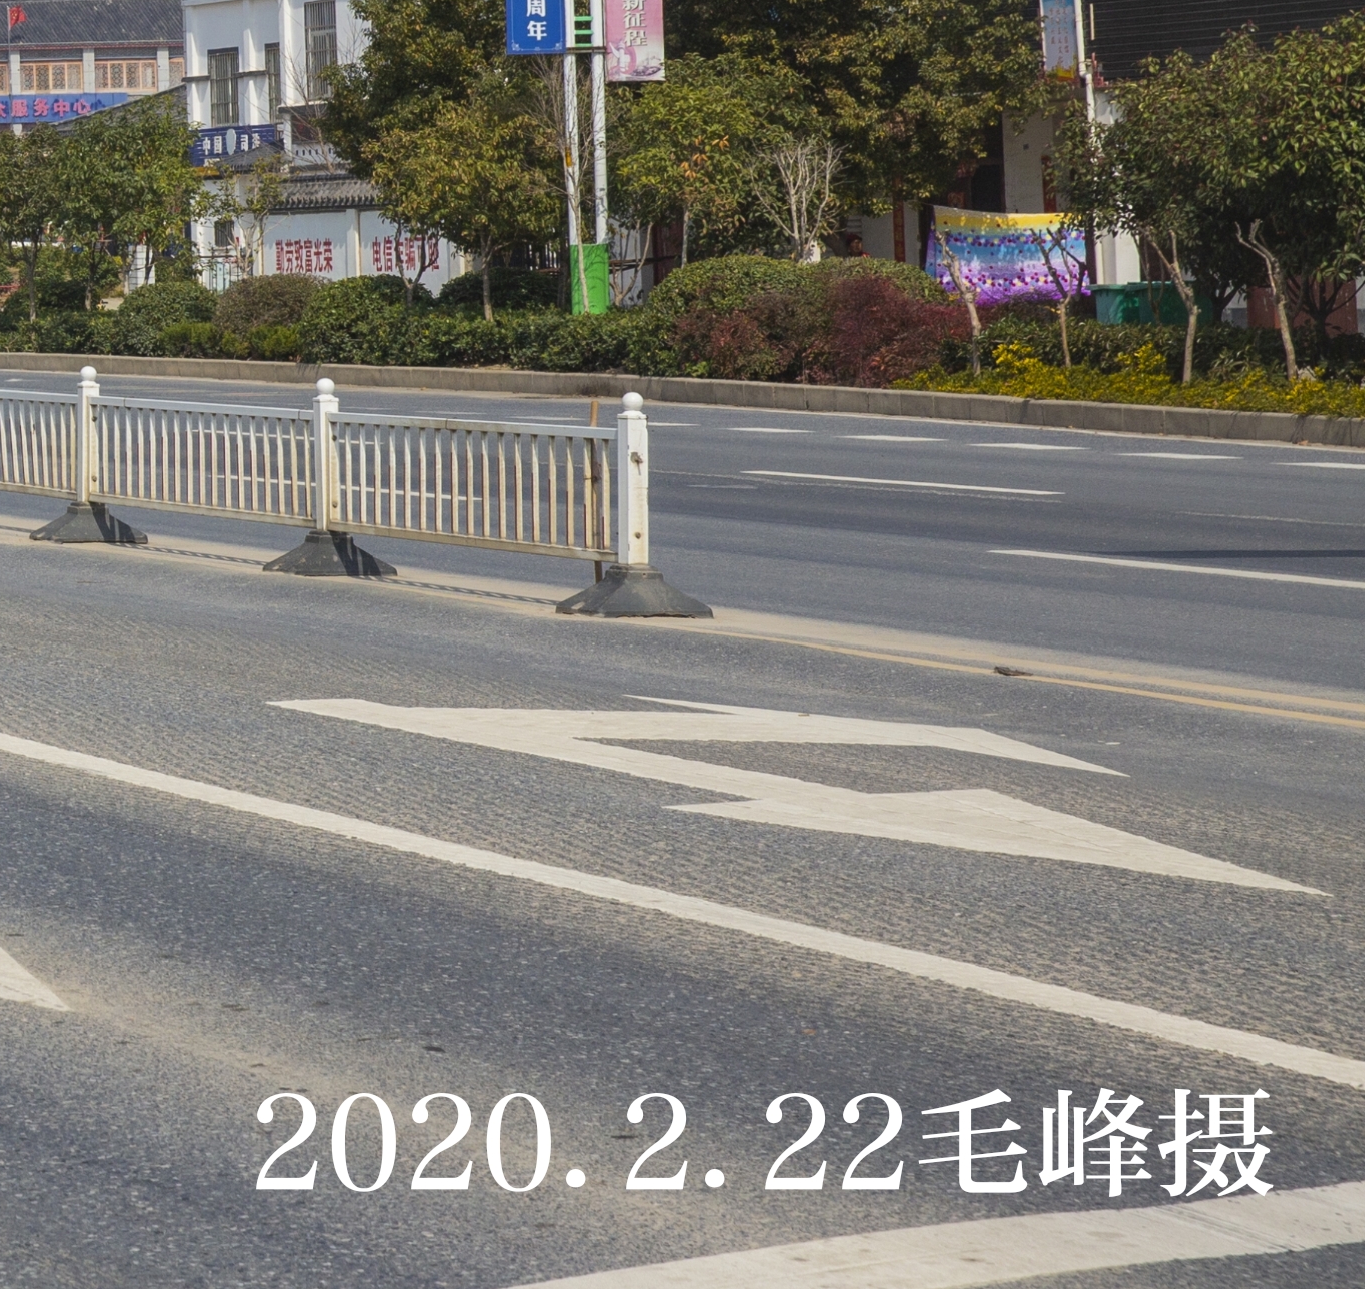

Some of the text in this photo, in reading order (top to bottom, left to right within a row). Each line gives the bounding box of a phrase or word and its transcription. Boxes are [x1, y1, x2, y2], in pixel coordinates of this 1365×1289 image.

[202, 135, 222, 155] 中国
[275, 237, 333, 273] 勤劳致富光荣
